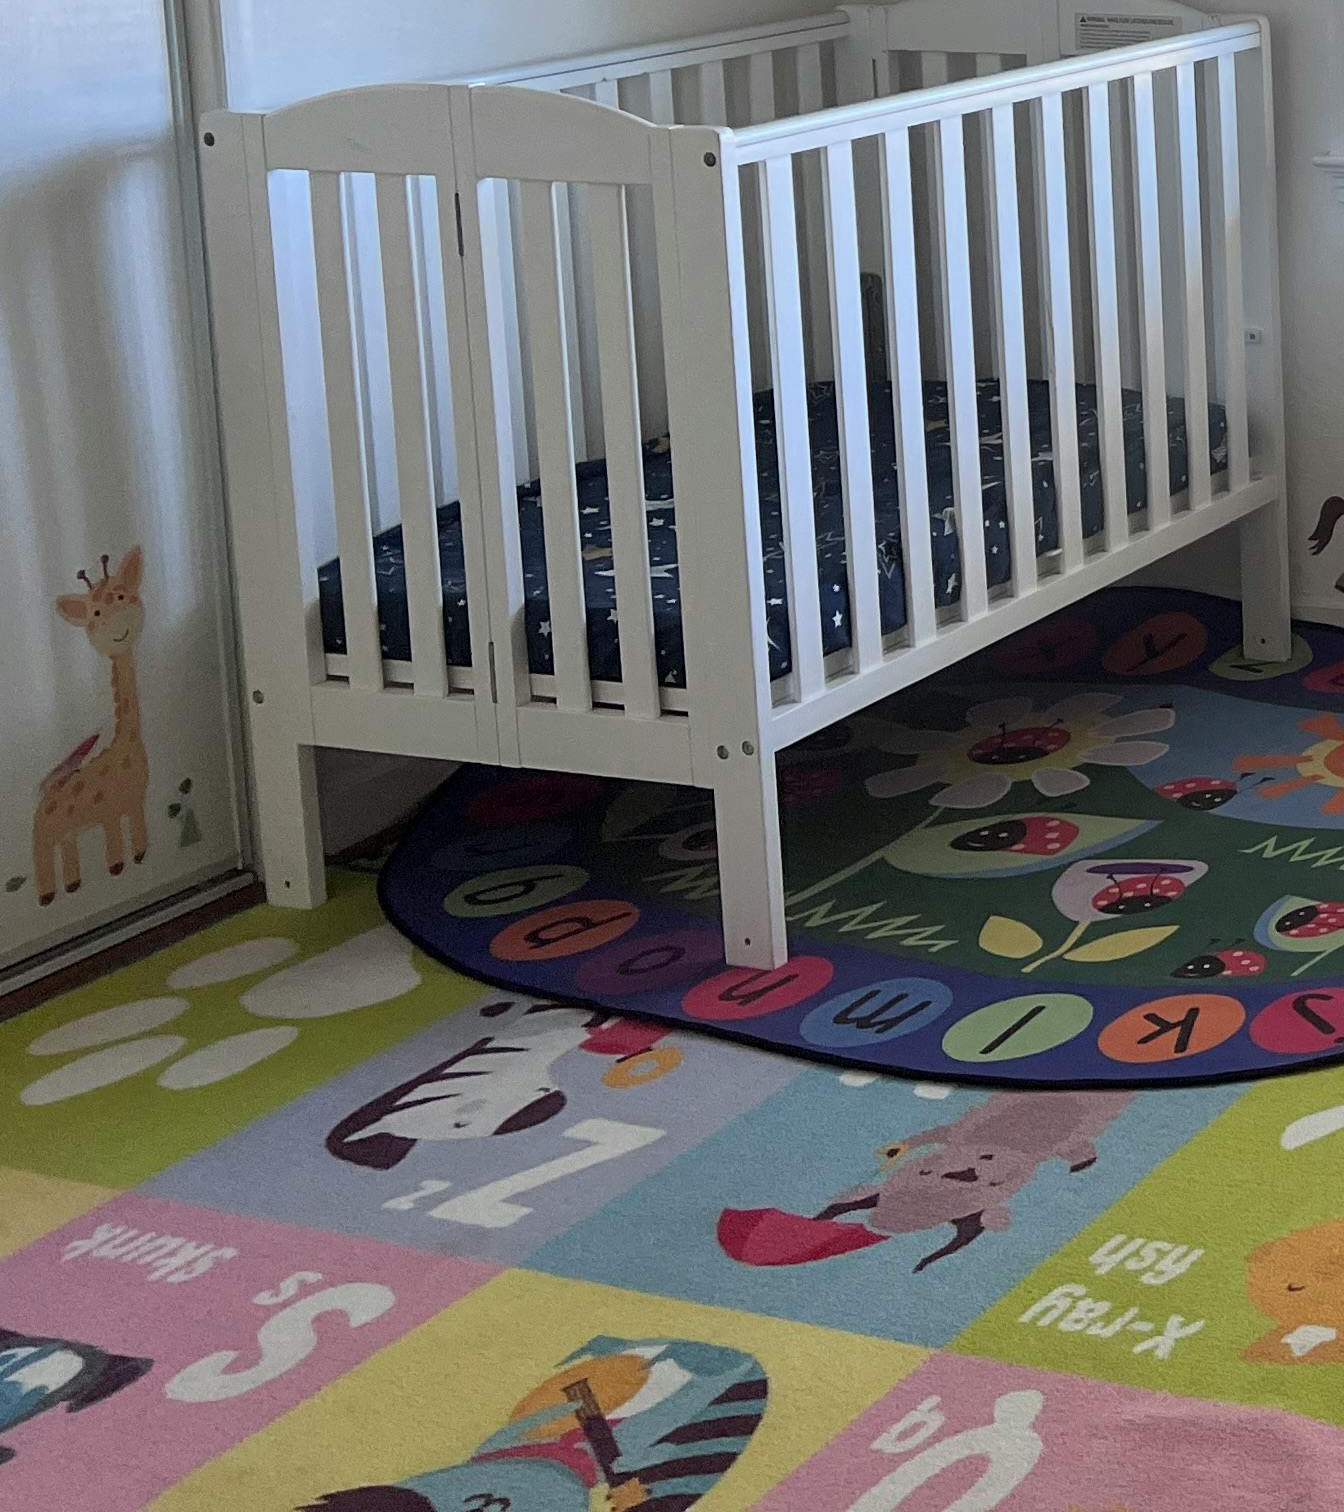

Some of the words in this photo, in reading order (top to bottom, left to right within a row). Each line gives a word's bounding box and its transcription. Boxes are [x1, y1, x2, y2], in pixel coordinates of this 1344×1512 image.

[831, 988, 934, 1034] m
[60, 1222, 240, 1284] Skunk
[1088, 1233, 1206, 1284] fish
[1018, 1283, 1206, 1360] X-ray
